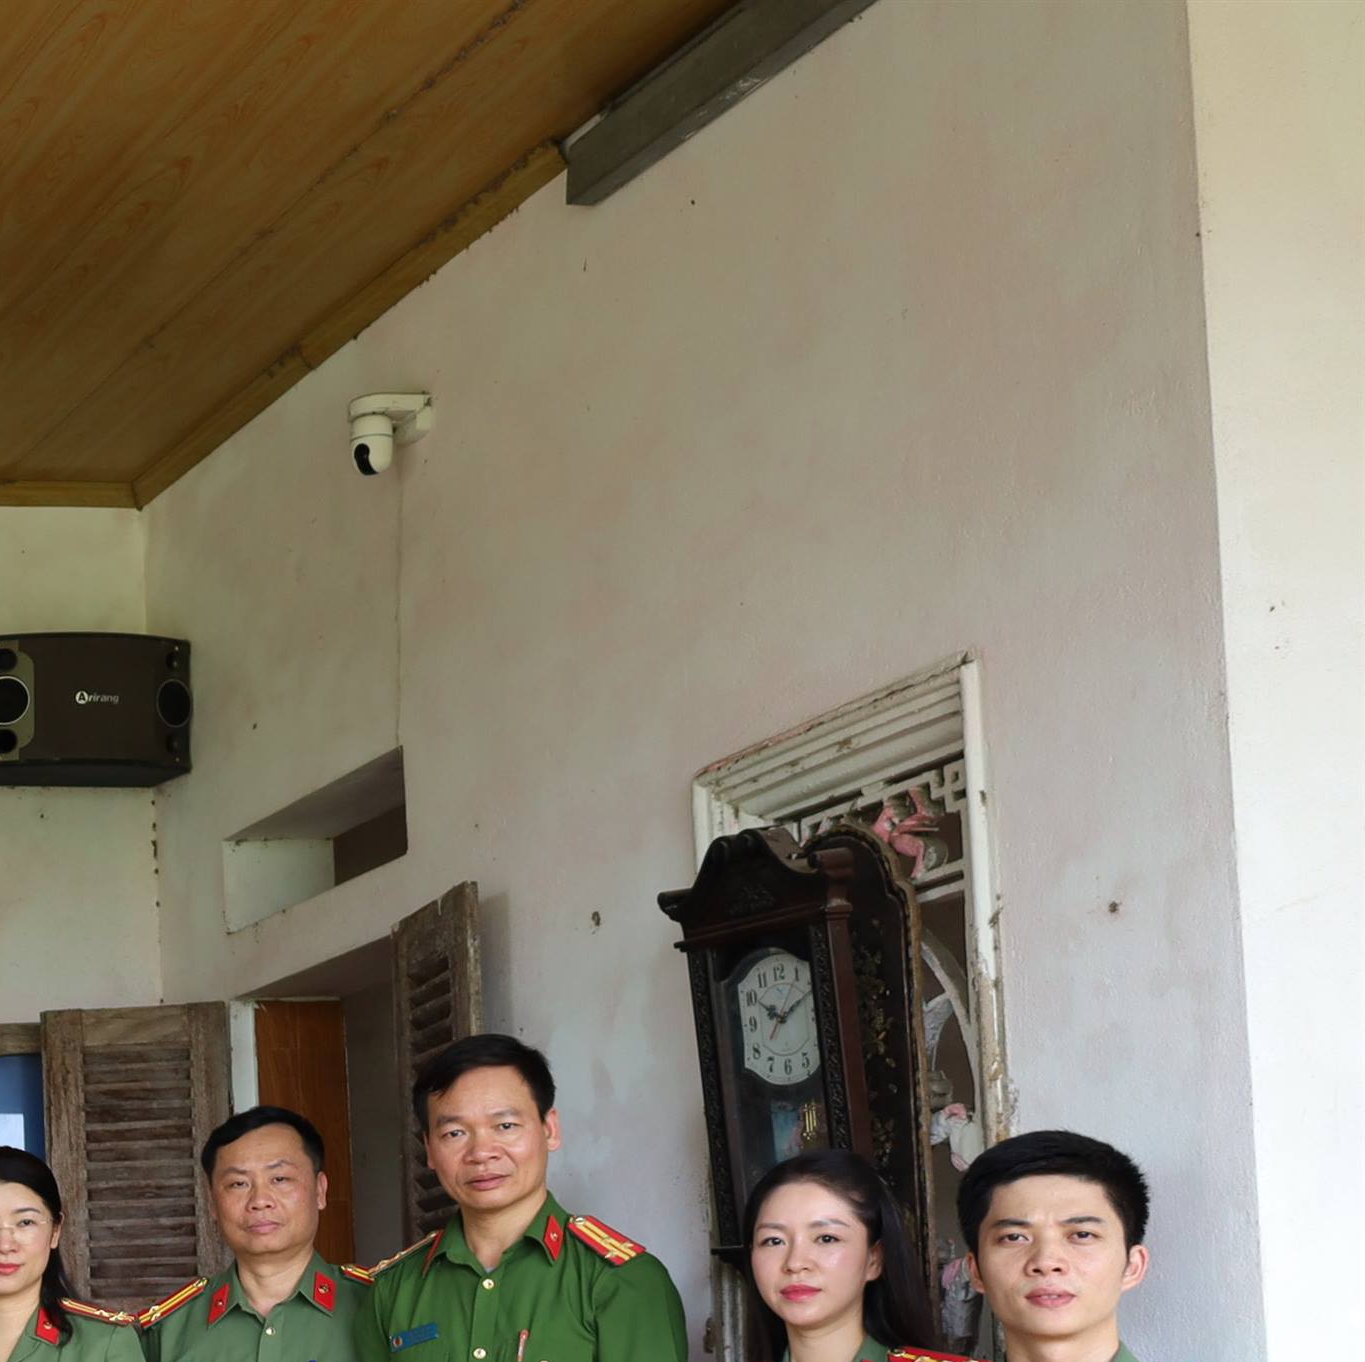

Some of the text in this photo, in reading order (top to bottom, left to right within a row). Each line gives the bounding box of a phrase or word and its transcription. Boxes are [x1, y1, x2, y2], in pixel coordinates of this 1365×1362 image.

[75, 691, 119, 705] Arirang
[758, 972, 767, 988] 11
[773, 963, 786, 981] 12
[746, 989, 757, 1007] 10
[749, 1016, 757, 1033] 9
[753, 1042, 761, 1060] 8
[767, 1056, 774, 1073] 7
[784, 1058, 792, 1075] 6
[802, 1051, 810, 1069] 5
